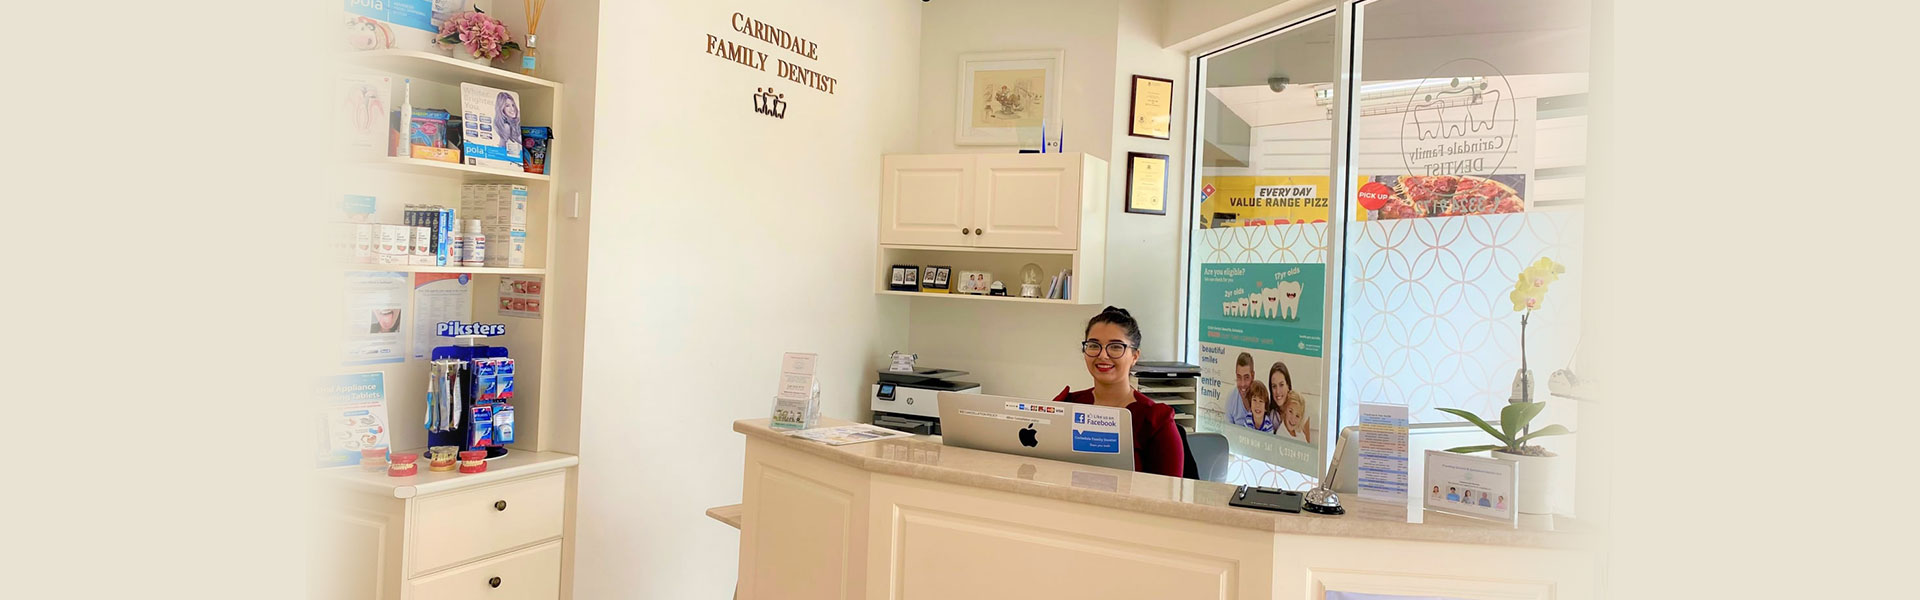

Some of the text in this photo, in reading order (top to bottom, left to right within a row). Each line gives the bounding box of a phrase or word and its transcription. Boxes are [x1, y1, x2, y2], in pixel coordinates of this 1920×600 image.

[732, 12, 818, 61] CARINDALE
[706, 33, 837, 94] FAMILY DENTIST
[466, 146, 484, 155] pola
[1260, 187, 1313, 197] EVERY DAY
[1358, 191, 1376, 199] PICK
[1230, 198, 1262, 207] VALUE
[1265, 198, 1301, 208] RANGE
[1214, 269, 1223, 277] you
[1223, 268, 1245, 277] eligible?
[1274, 267, 1301, 280] 17yr olds
[1233, 288, 1245, 296] olds
[437, 321, 505, 336] Piksters
[1202, 345, 1226, 355] beautiful
[1201, 355, 1218, 364] smiles
[1201, 377, 1221, 388] entire
[335, 383, 377, 393] Appliance
[1201, 387, 1221, 400] family
[1087, 418, 1116, 427] Facebook
